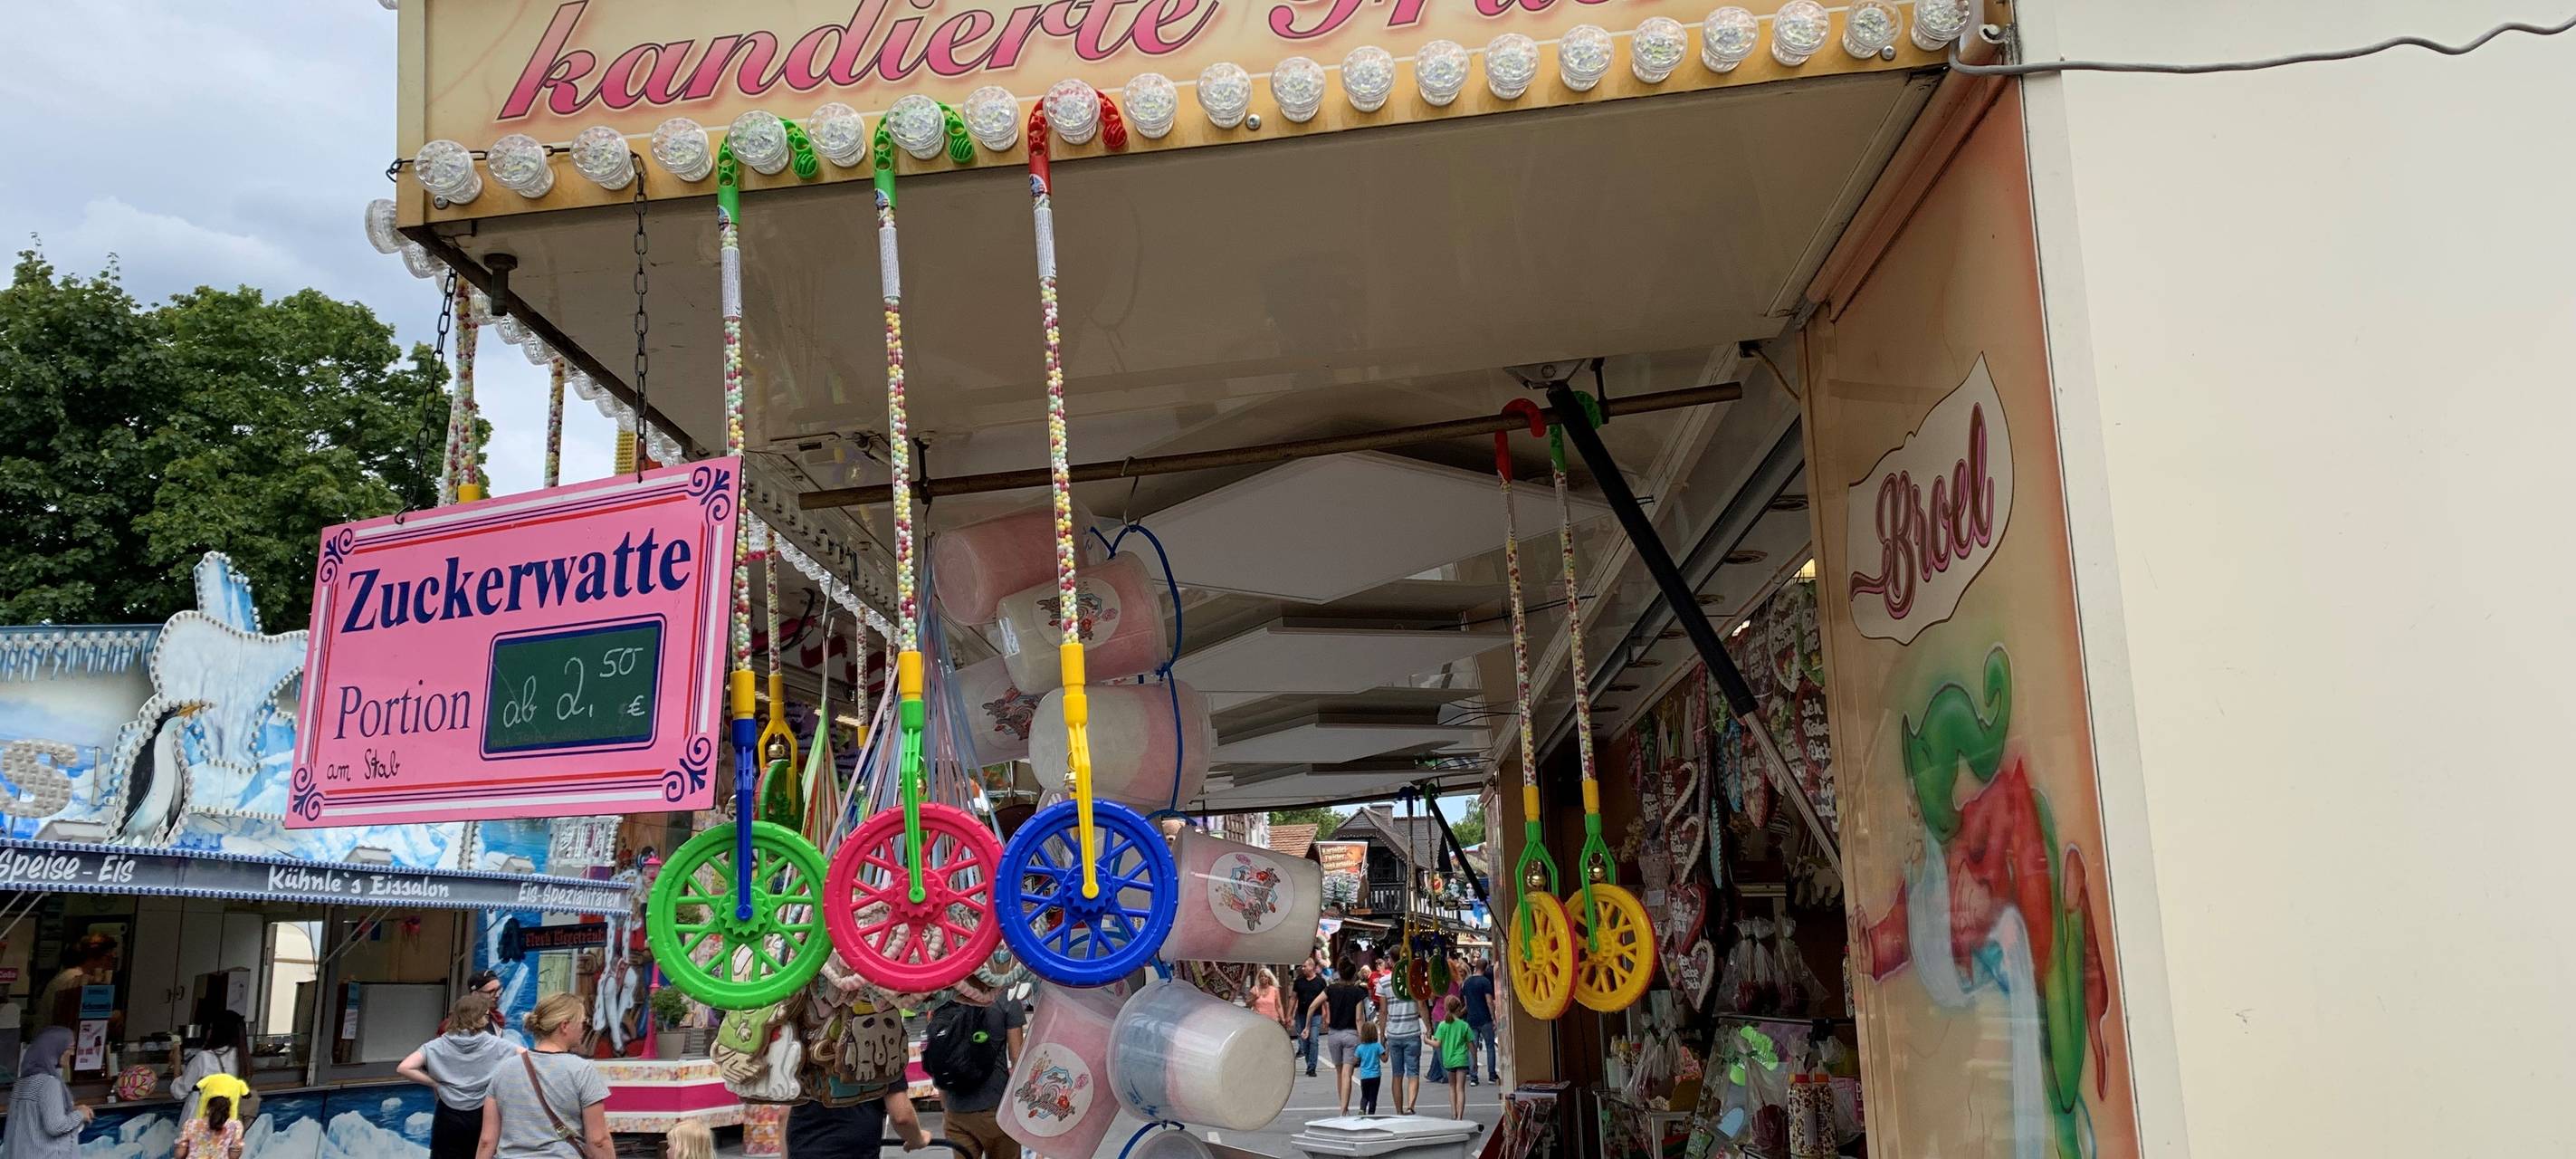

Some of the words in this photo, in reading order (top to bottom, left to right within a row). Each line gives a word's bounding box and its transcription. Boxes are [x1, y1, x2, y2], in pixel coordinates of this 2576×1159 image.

[497, 0, 1220, 120] kandierte
[1850, 402, 1995, 619] Broel
[340, 527, 692, 634] Zuckerwatte
[333, 679, 472, 740] Portion
[501, 675, 538, 728] ab
[627, 696, 645, 716] €
[327, 761, 351, 782] am
[364, 749, 400, 781] Stab
[0, 848, 80, 882] Speise
[99, 855, 136, 883] Eis
[370, 875, 450, 899] Eissalon
[518, 882, 622, 909] Eis-Spezialitäten
